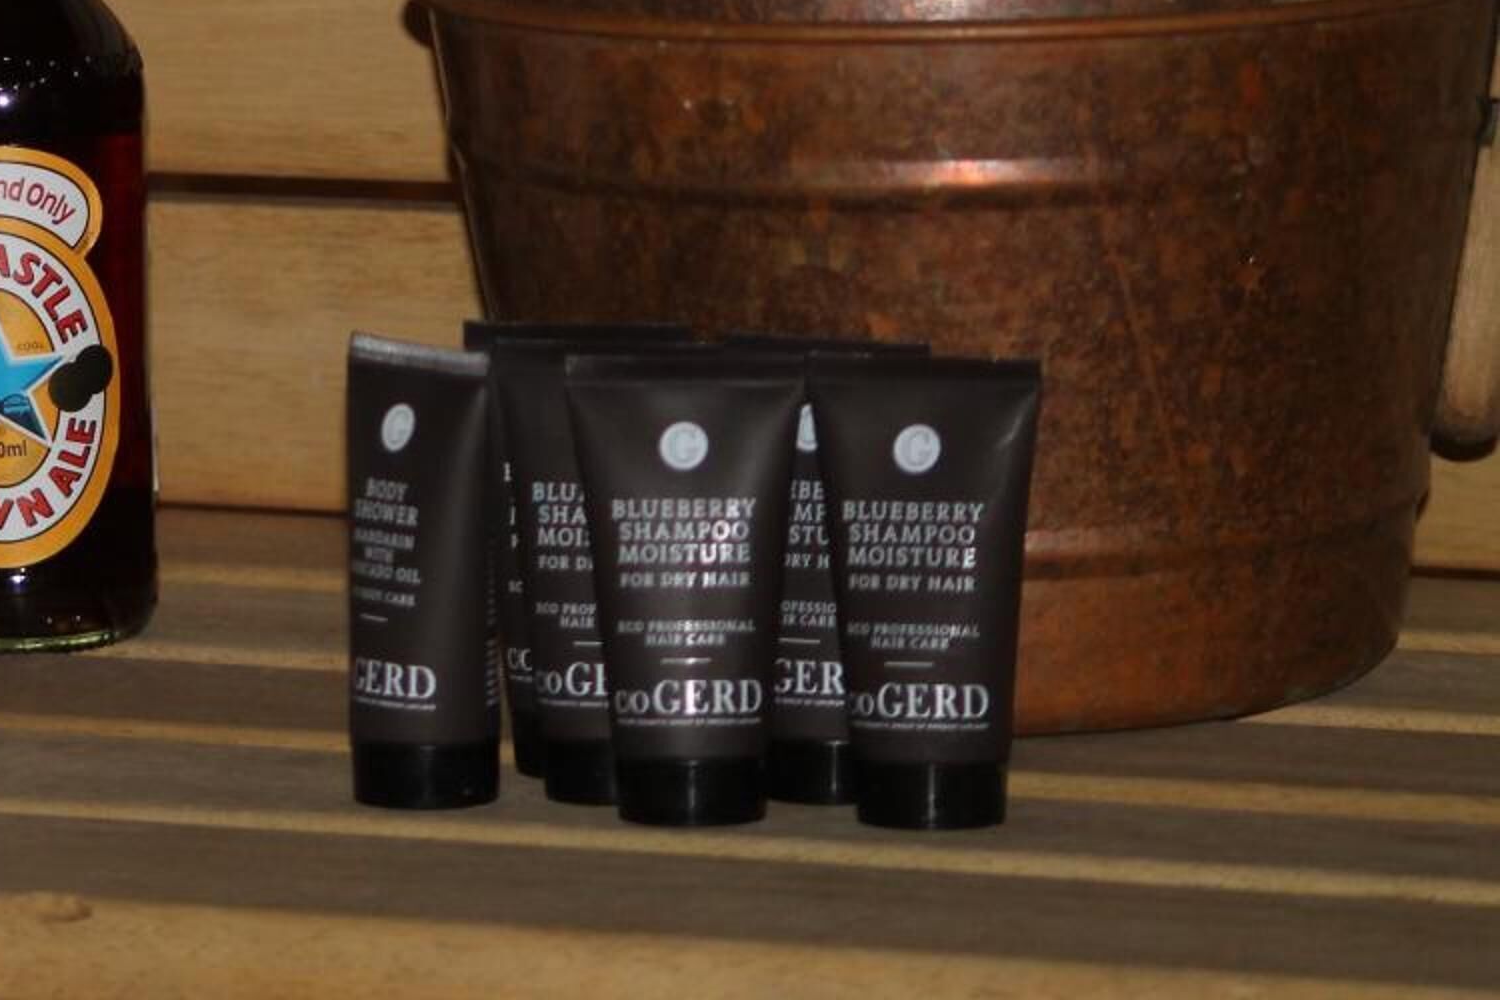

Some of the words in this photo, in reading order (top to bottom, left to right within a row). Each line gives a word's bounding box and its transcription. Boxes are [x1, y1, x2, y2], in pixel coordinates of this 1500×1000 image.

[26, 182, 76, 226] Only
[48, 417, 97, 498] ALE
[366, 477, 408, 501] BODY
[532, 481, 585, 503] BLU
[611, 497, 756, 519] BLUEBERRY
[842, 501, 984, 523] BLUEBERRY
[619, 520, 749, 541] SHAMPOO
[849, 522, 976, 545] SHAMPOO
[538, 555, 570, 570] FOR
[618, 543, 751, 564] MOISTURE
[847, 545, 977, 569] MOISTURE
[619, 572, 655, 588] FOR
[660, 572, 698, 588] DRY
[702, 571, 750, 588] HAIR
[849, 573, 881, 590] FOR
[885, 574, 921, 592] DRY
[927, 575, 976, 593] HAIR
[648, 619, 756, 633] PROFESSIONAL
[873, 622, 980, 638] PROFESSIONAL
[645, 633, 682, 647] HAIR
[684, 633, 726, 647] CARE
[871, 636, 905, 649] HAIR
[909, 637, 950, 650] CARE
